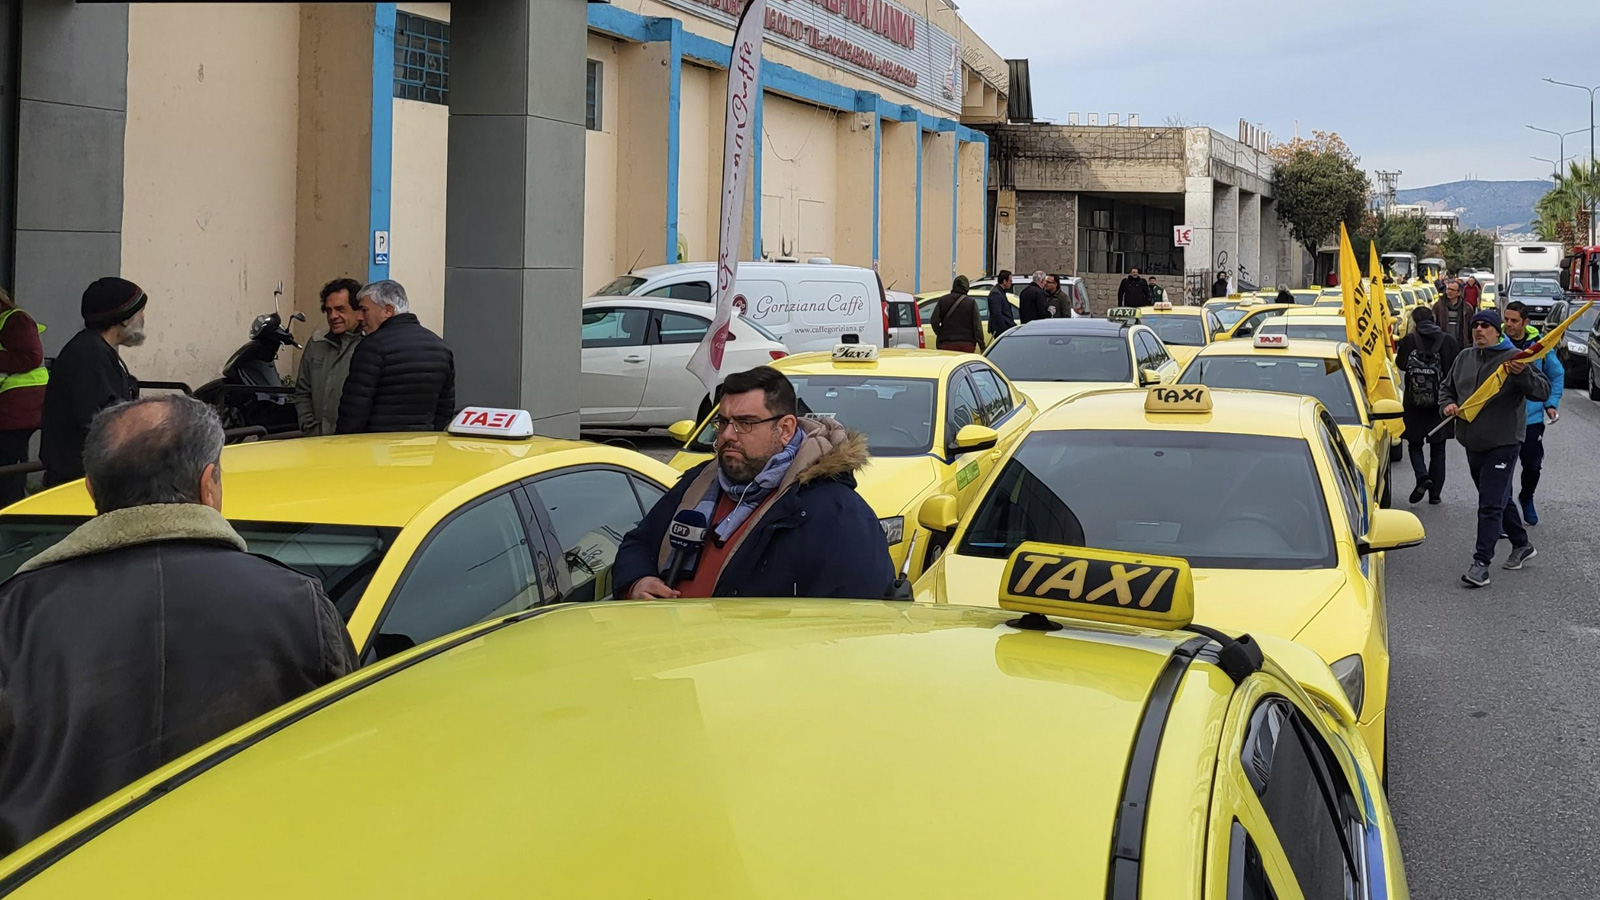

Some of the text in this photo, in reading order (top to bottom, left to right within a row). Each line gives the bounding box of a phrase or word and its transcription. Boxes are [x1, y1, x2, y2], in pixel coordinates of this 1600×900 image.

[379, 235, 385, 249] P
[1176, 228, 1191, 243] 1€
[794, 325, 865, 335] www.caffegoriziana.gr
[832, 346, 873, 359] Taxi
[1152, 388, 1204, 403] TAXI
[461, 411, 517, 428] ΤΑΞΙ
[1013, 554, 1174, 608] TAXI
